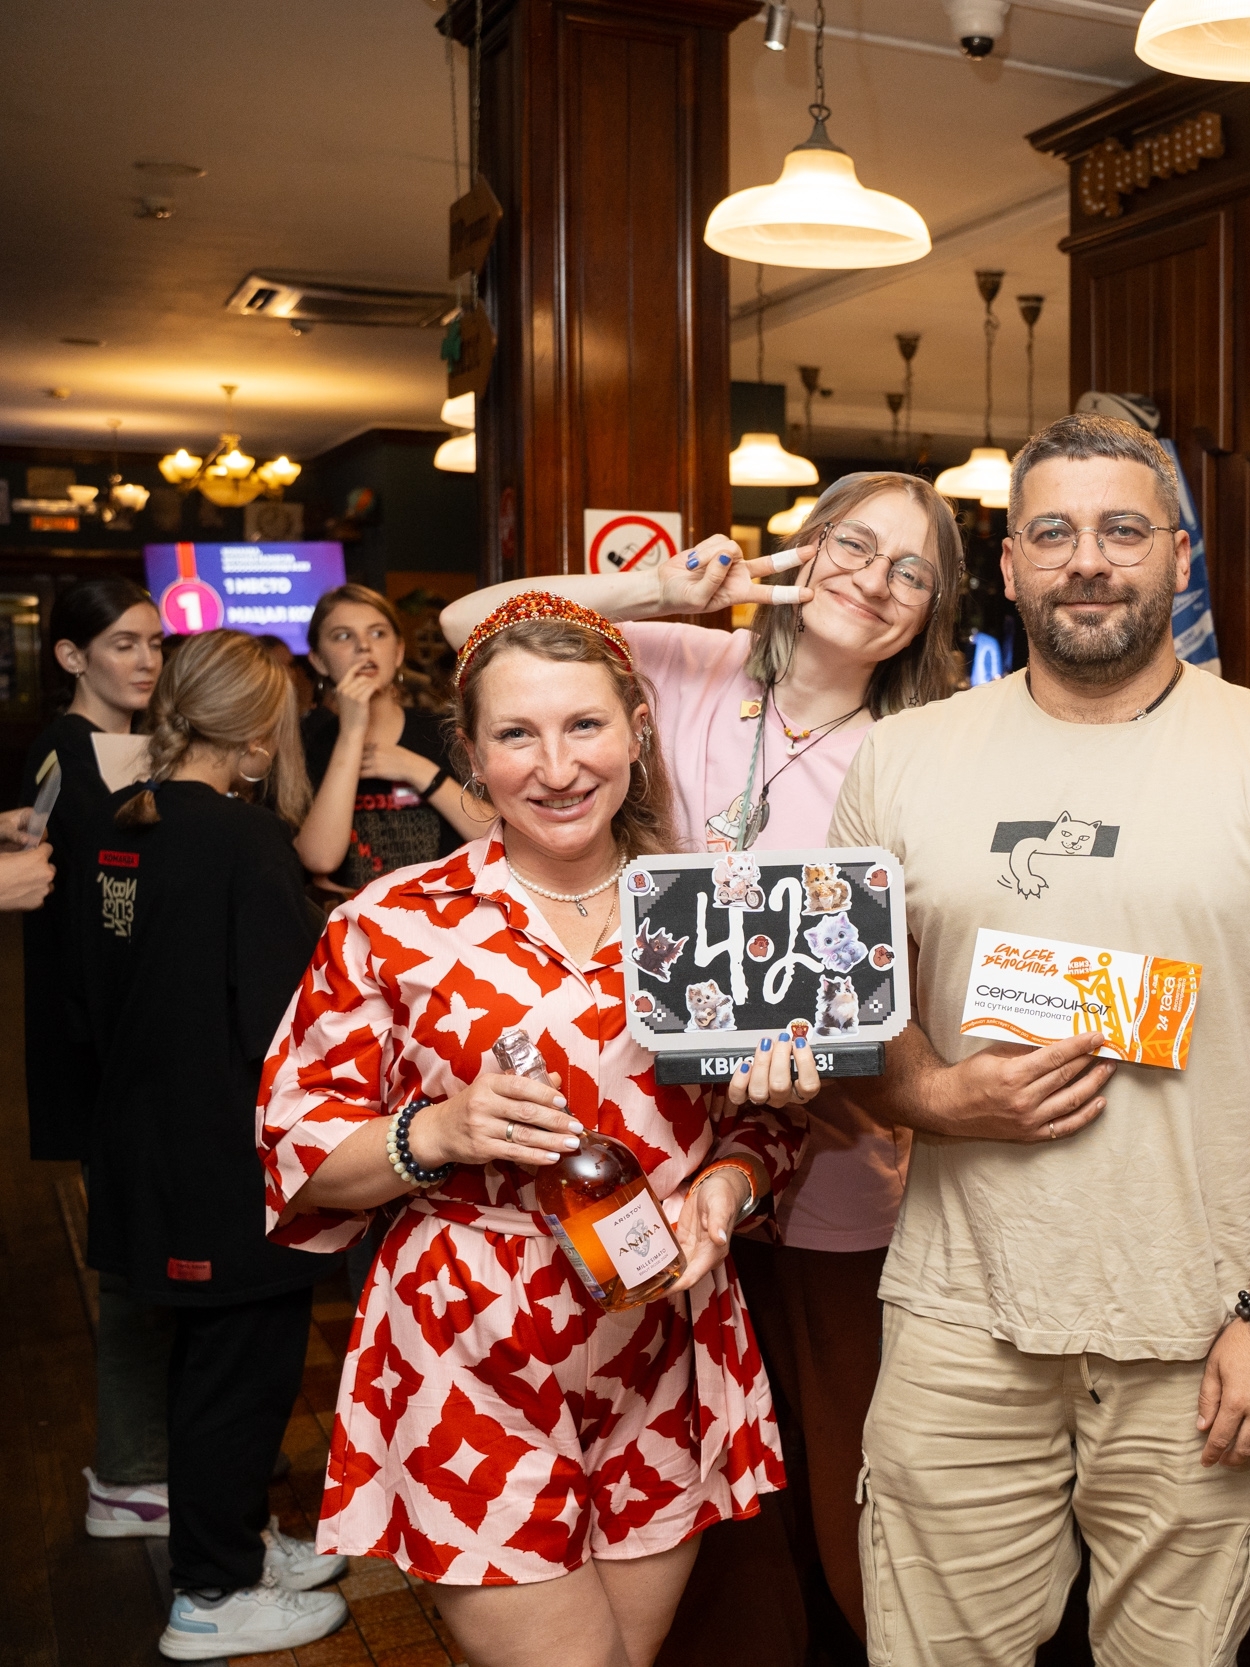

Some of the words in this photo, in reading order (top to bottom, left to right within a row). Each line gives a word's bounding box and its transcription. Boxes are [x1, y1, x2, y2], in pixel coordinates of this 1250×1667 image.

[176, 591, 203, 631] 1
[694, 877, 825, 1006] 42
[981, 954, 1059, 977] ВЕЛОСИПЕД
[1022, 949, 1055, 962] СЕБЕ
[974, 1000, 986, 1008] на
[987, 1002, 1013, 1012] сутки
[1014, 1006, 1072, 1022] велопроката
[976, 984, 1112, 1017] сертификат
[1157, 1014, 1169, 1032] 24
[613, 1204, 642, 1227] ARISTOV
[619, 1223, 661, 1257] ANIMA
